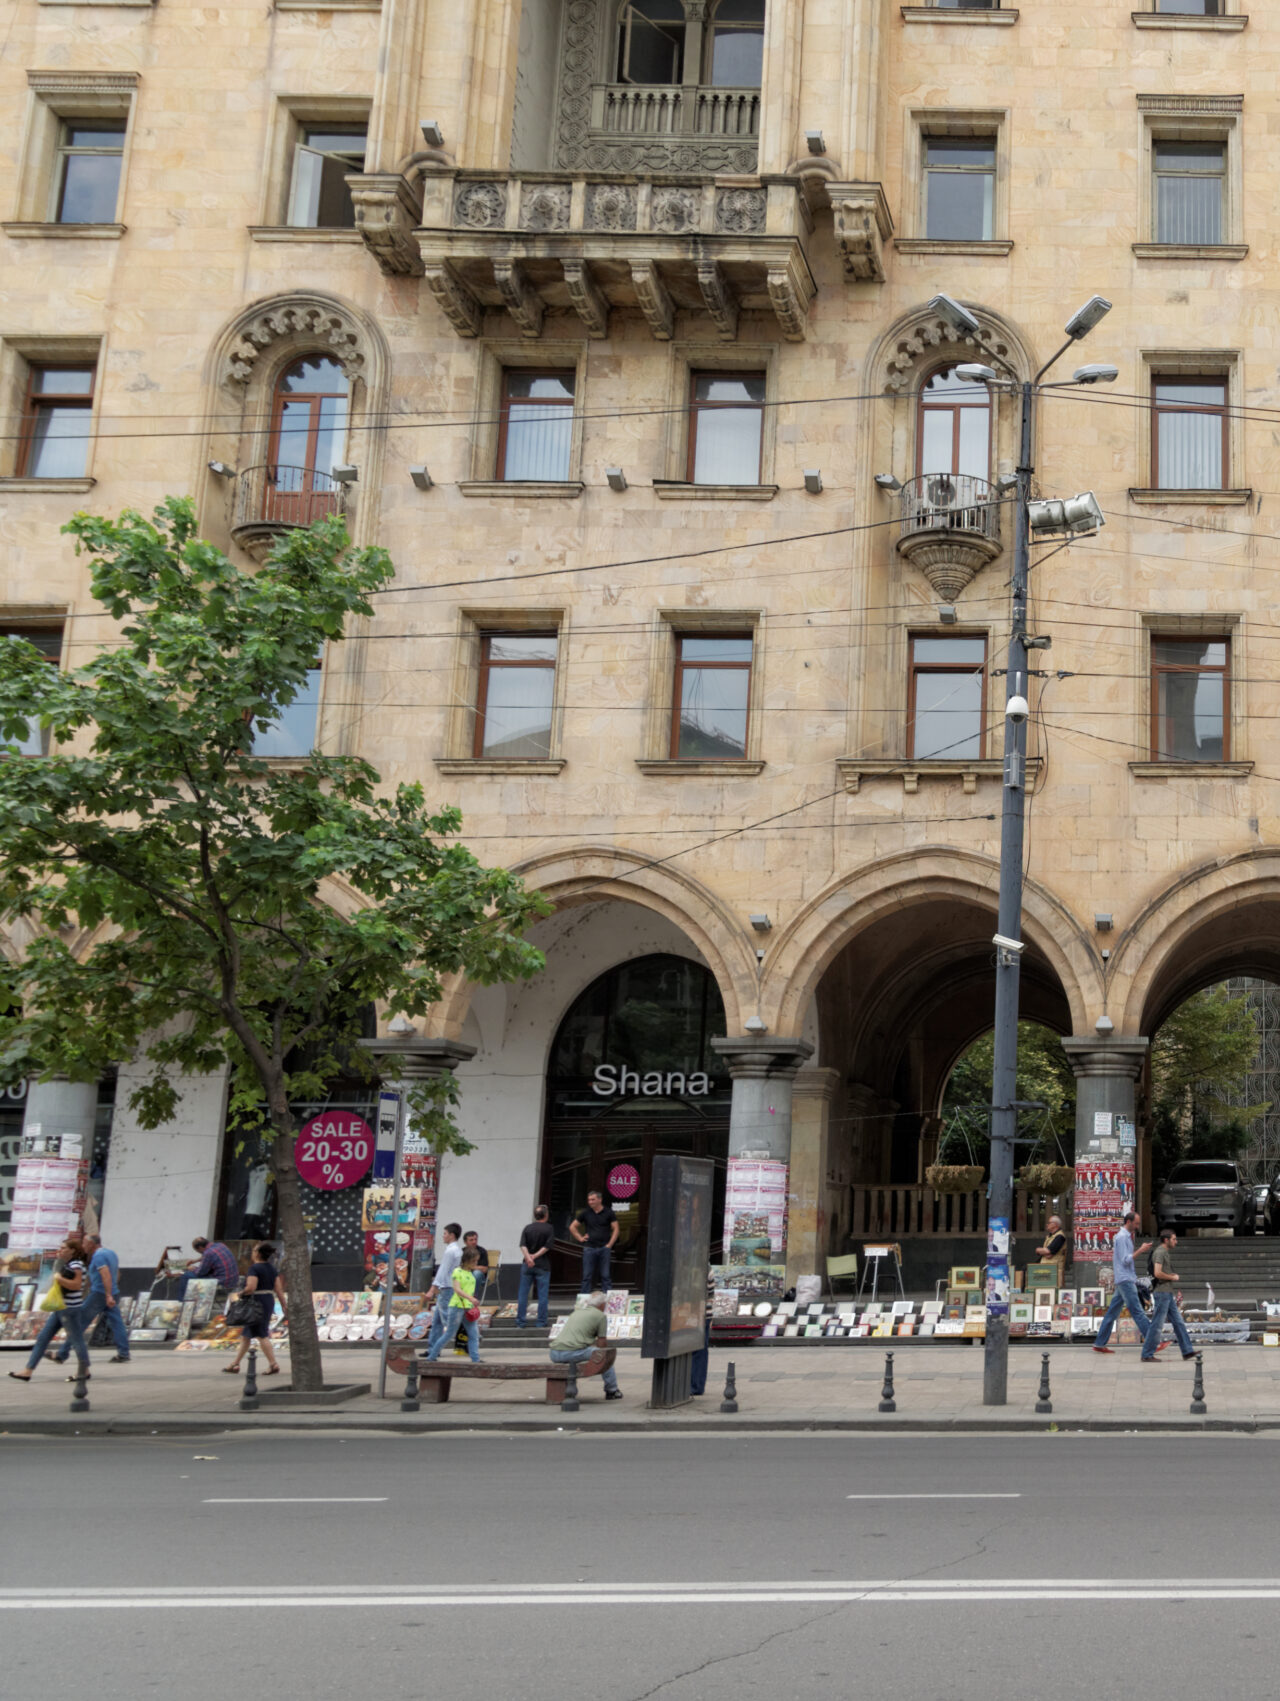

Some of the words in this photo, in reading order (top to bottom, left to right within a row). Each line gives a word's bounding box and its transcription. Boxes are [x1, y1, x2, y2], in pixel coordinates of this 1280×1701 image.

[592, 1064, 709, 1096] Shana
[311, 1122, 362, 1138] SALE
[301, 1140, 368, 1162] 20-30
[322, 1163, 344, 1185] %
[609, 1176, 637, 1185] SALE
